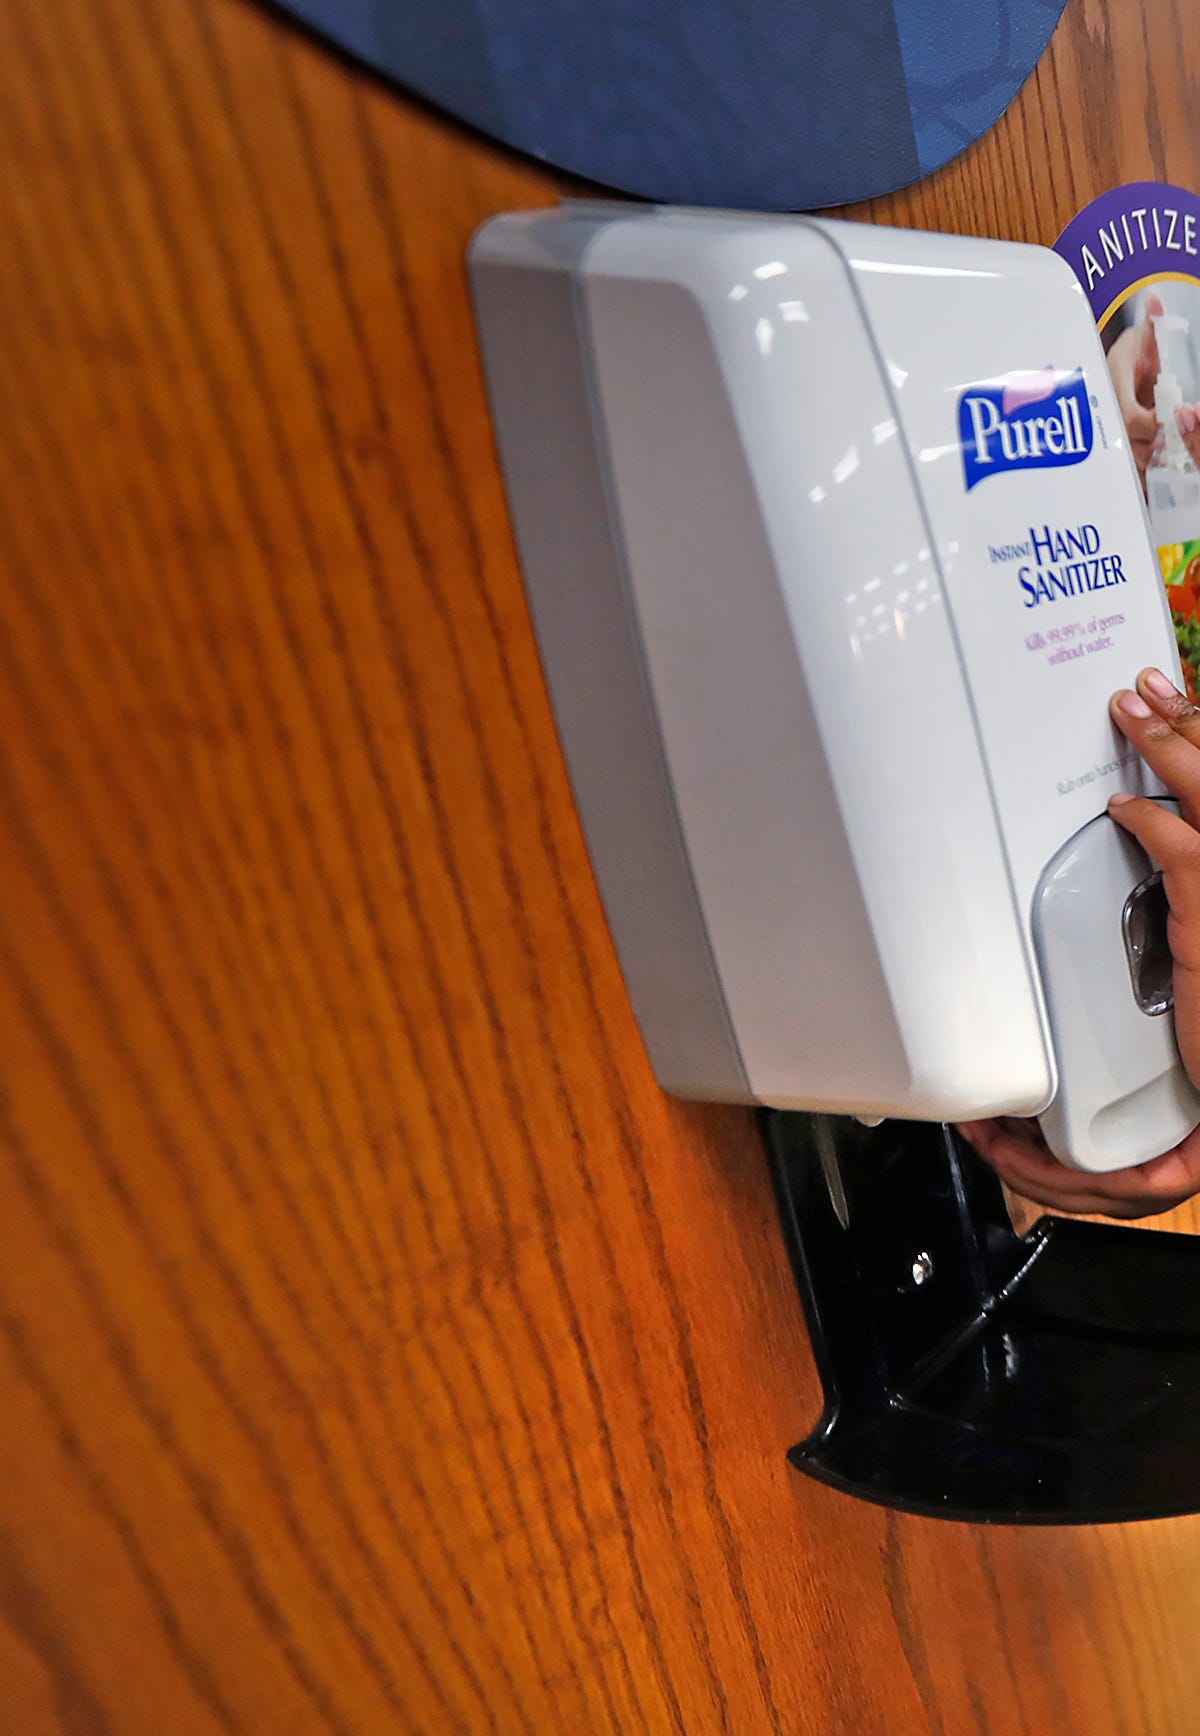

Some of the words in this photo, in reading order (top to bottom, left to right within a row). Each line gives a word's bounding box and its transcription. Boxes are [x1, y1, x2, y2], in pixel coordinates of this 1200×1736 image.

[1081, 208, 1198, 291] ANITIZE
[965, 396, 1088, 463] Purell
[1029, 524, 1101, 566] HAND
[1018, 554, 1127, 608] SANITIZER
[1096, 613, 1125, 633] germs
[1048, 642, 1085, 665] without
